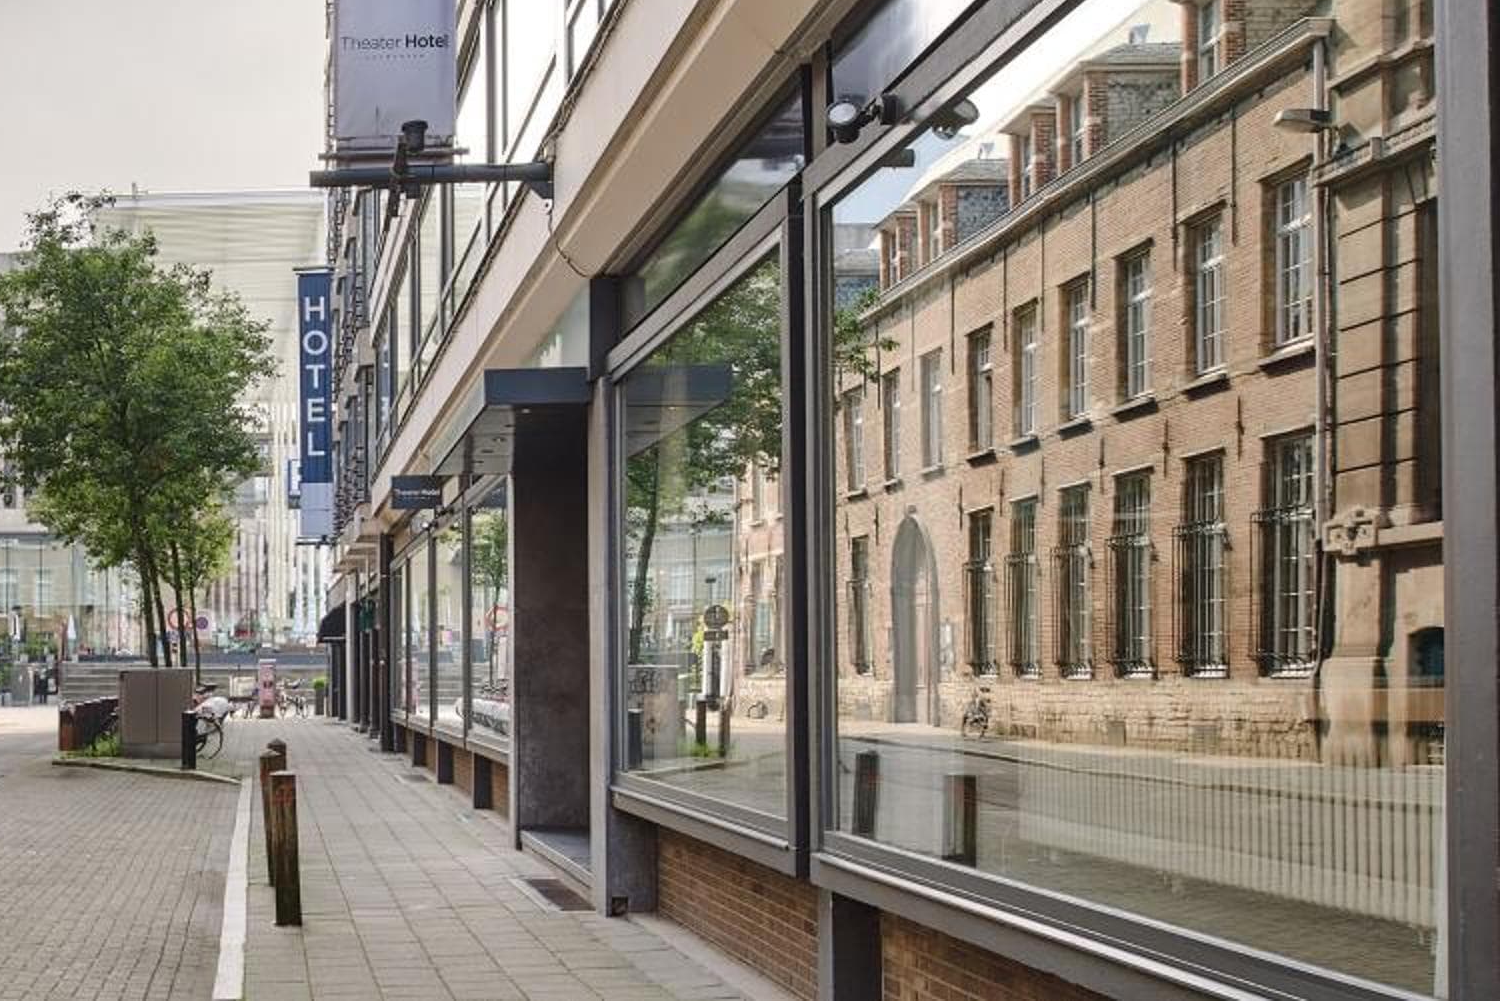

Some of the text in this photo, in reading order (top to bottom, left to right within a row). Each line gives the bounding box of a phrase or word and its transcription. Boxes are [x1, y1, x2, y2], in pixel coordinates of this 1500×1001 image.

[340, 33, 449, 50] Theater Hotel
[303, 297, 328, 456] HOTEL
